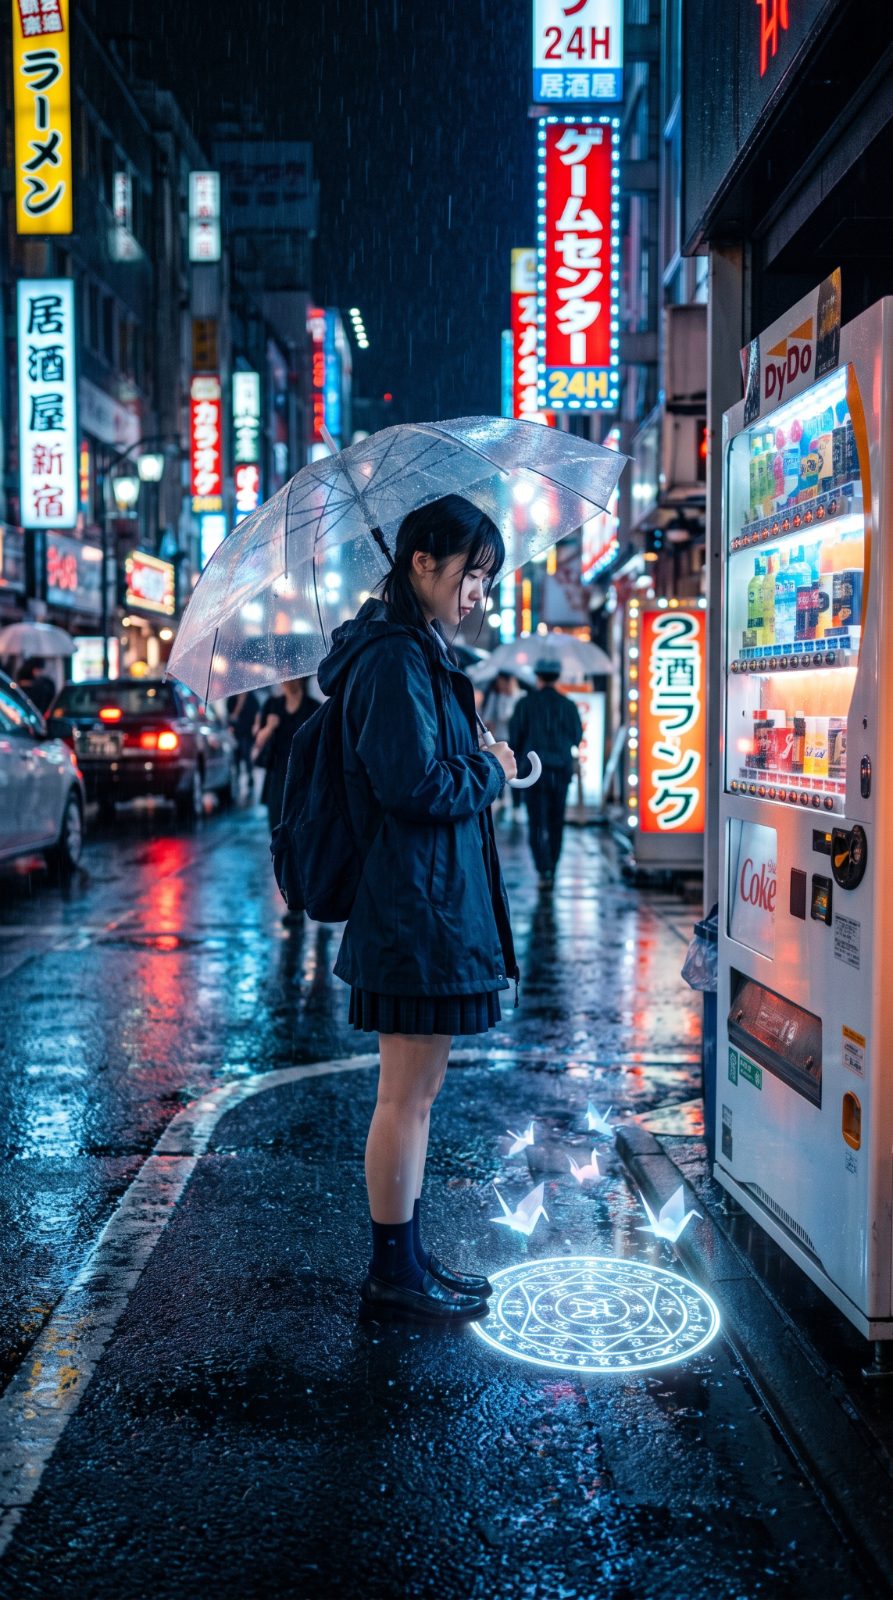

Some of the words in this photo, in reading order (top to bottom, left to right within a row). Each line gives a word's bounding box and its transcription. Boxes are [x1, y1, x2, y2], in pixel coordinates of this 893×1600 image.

[544, 26, 610, 60] 24H
[540, 73, 616, 98] 居酒屋
[22, 50, 63, 215] ラーメン
[555, 128, 604, 365] ゲームセンター
[548, 370, 609, 399] 24H
[765, 344, 812, 401] DyDo
[740, 858, 777, 912] Coke
